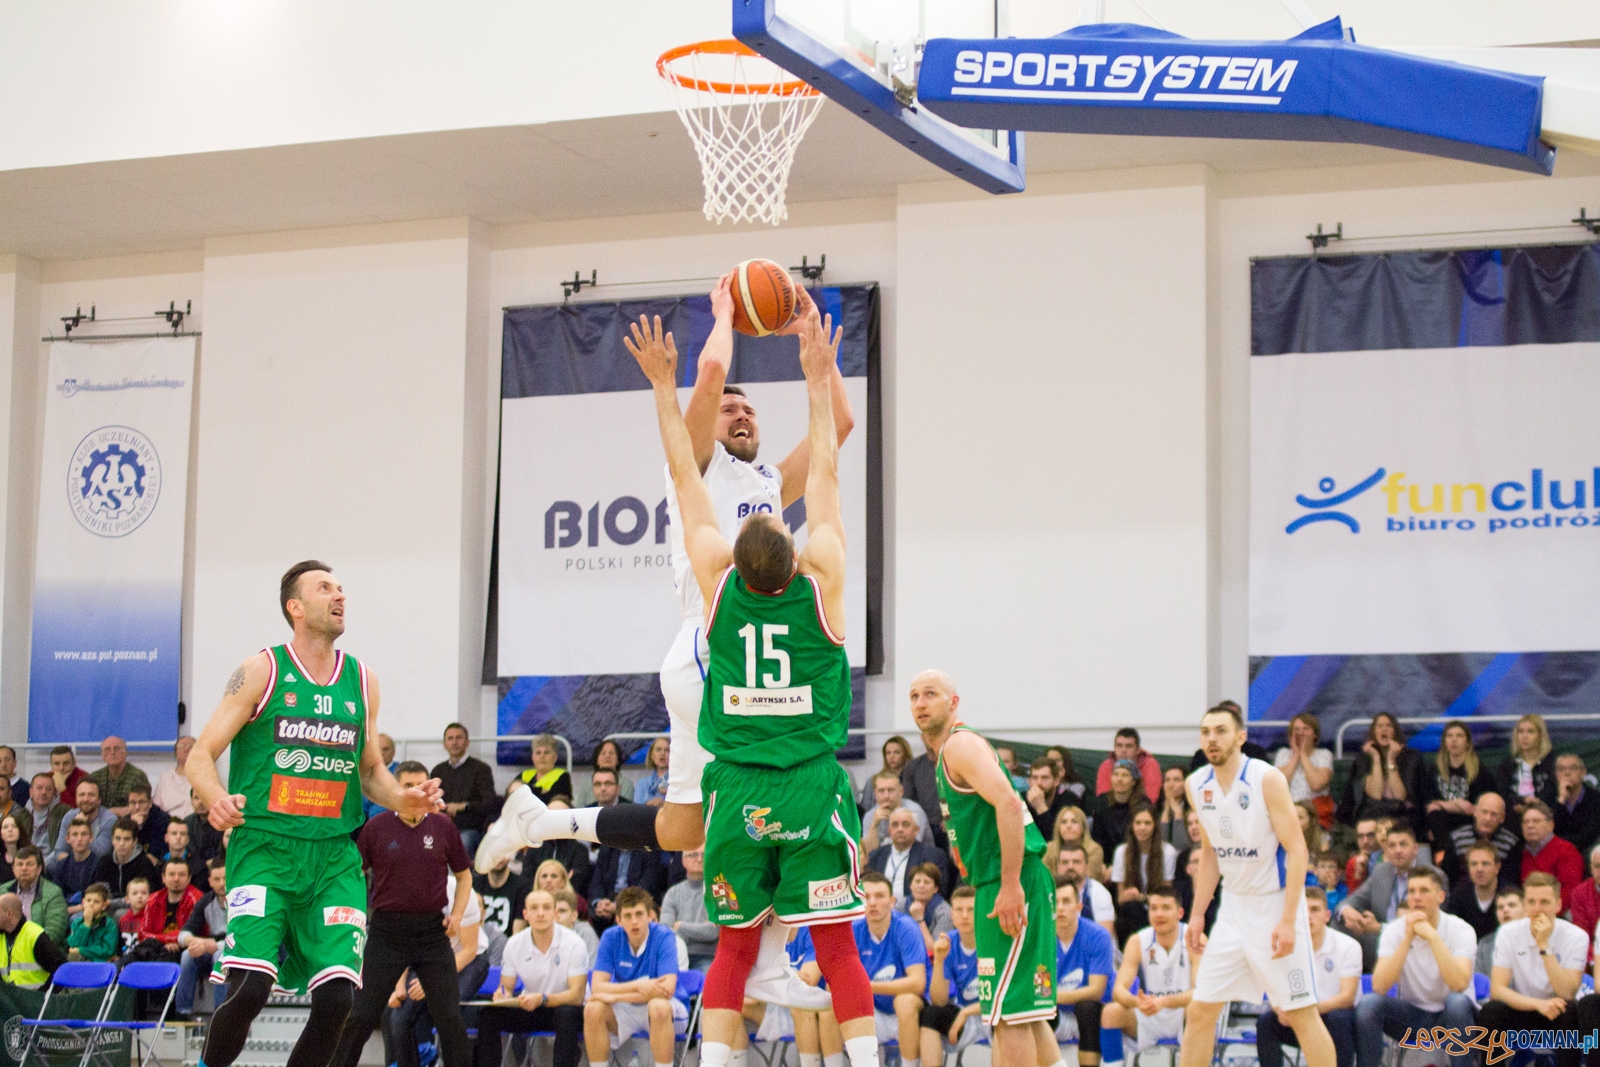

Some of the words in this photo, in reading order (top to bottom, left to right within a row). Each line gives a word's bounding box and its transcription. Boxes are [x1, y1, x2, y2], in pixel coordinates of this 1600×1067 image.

[98, 431, 155, 464] UCZELNIANY
[70, 477, 113, 532] POLITECHNIKI
[1387, 516, 1476, 532] biuro
[565, 556, 623, 571] POLSKI
[54, 648, 158, 662] www.azs.put.poznan.pl
[738, 622, 791, 689] 15
[313, 694, 333, 715] 30
[278, 719, 357, 746] totolotek
[1219, 815, 1233, 839] 8
[1212, 847, 1259, 858] OFARM
[978, 980, 992, 1001] 33
[1288, 968, 1306, 993] 8
